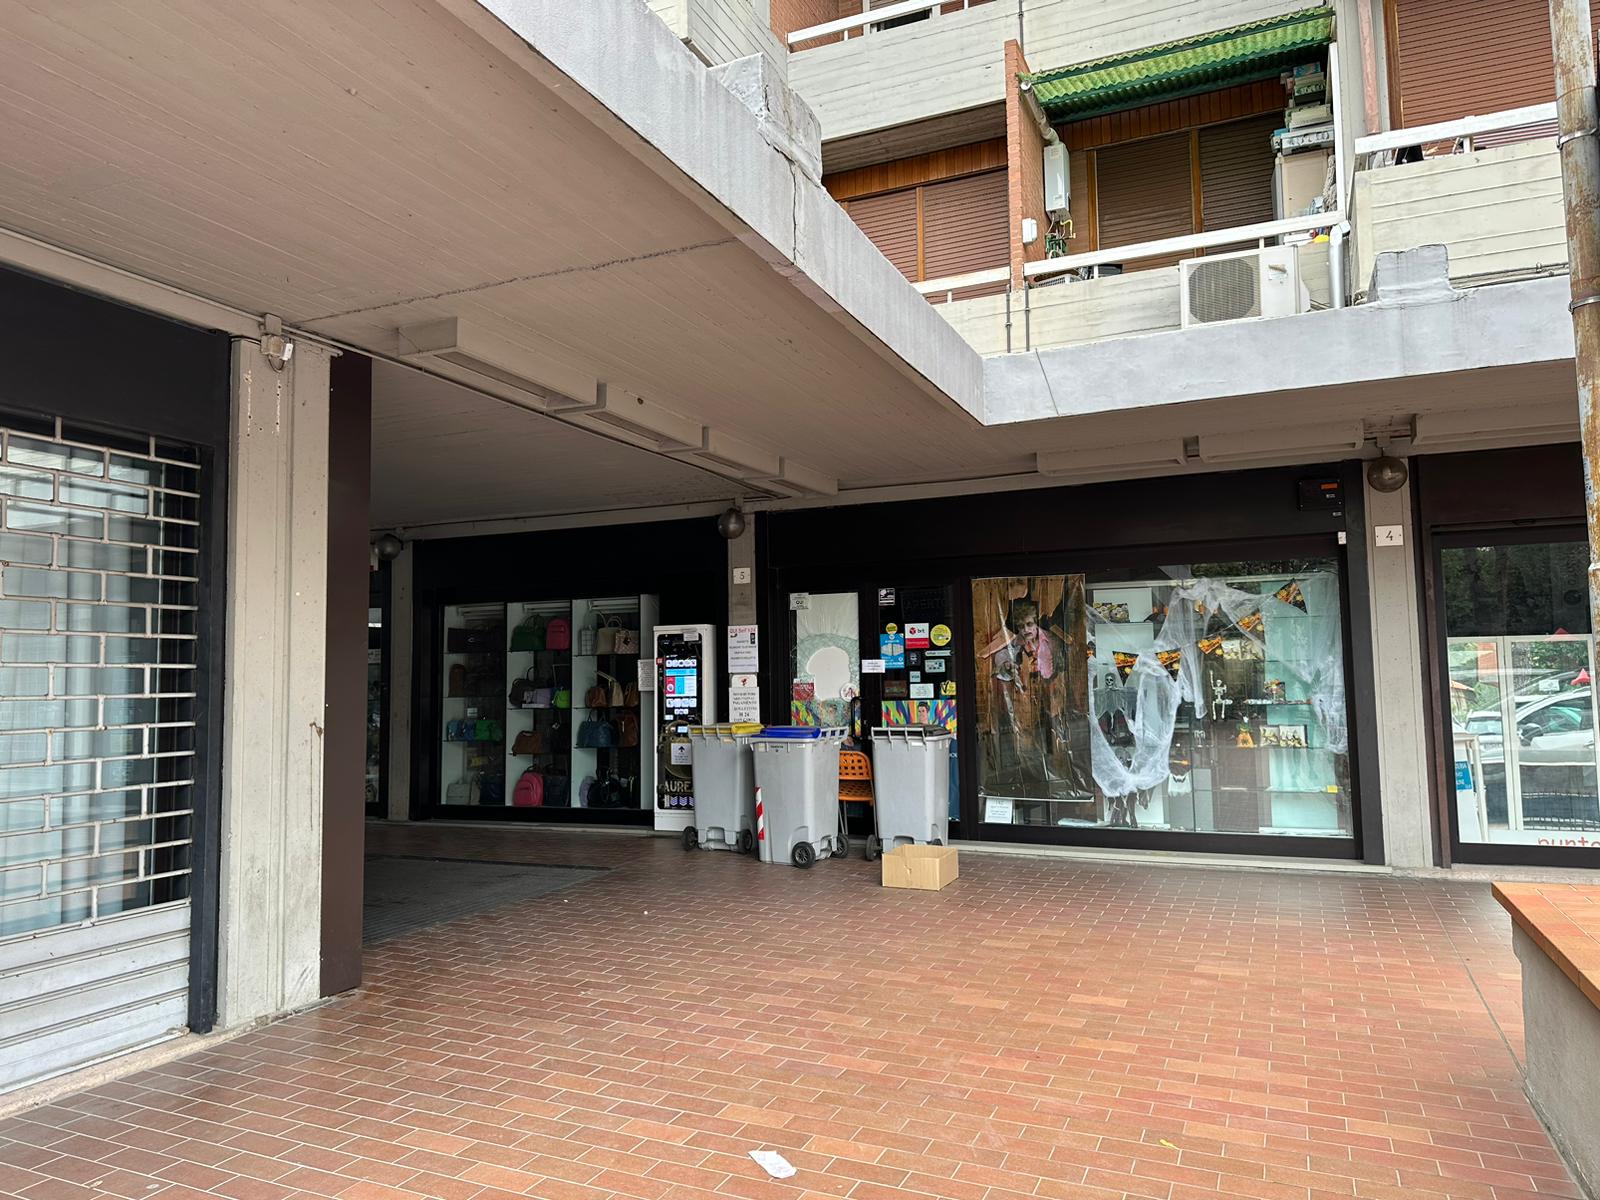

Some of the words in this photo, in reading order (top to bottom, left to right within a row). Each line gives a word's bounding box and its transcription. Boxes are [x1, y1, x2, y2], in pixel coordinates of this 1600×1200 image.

[1386, 530, 1394, 541] 4
[740, 571, 745, 580] 5
[664, 780, 694, 793] AURE
